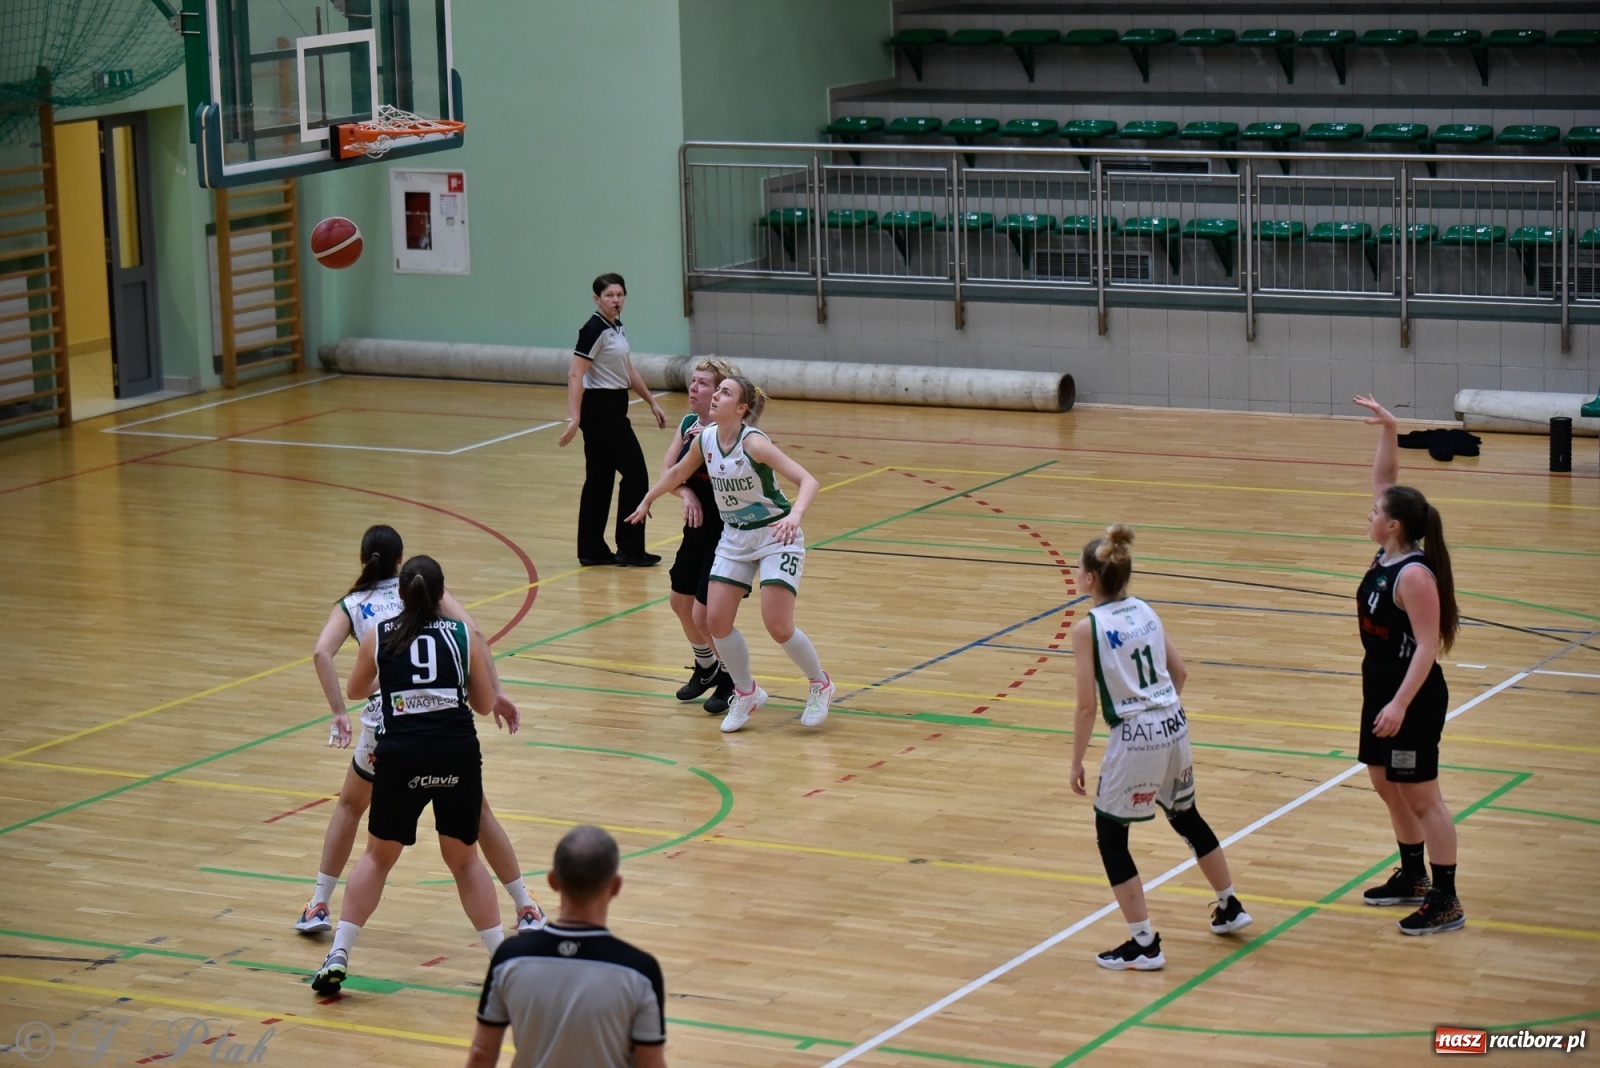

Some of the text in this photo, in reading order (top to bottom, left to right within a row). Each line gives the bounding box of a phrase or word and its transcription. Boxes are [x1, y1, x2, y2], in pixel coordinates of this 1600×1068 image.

[712, 477, 754, 492] TOWICE
[722, 495, 739, 506] 25
[780, 552, 799, 576] 25
[1367, 591, 1380, 614] 4
[410, 634, 437, 684] 9
[1130, 644, 1158, 689] 11
[1121, 697, 1138, 706] AZS
[1121, 706, 1187, 742] BAT-TRAN
[420, 774, 459, 787] Clavis
